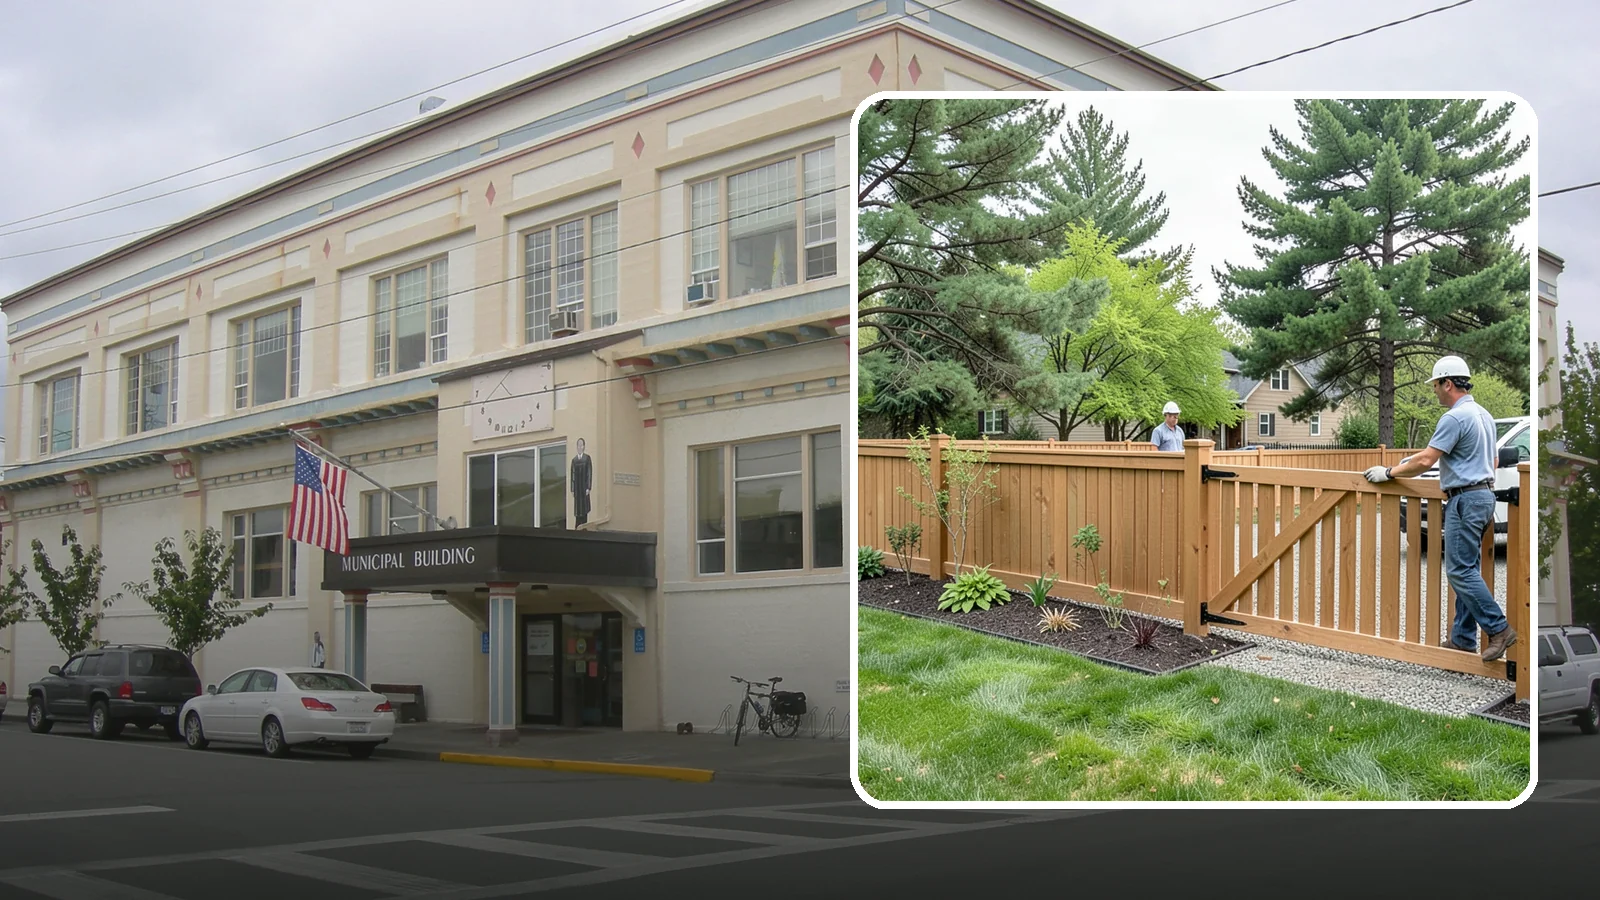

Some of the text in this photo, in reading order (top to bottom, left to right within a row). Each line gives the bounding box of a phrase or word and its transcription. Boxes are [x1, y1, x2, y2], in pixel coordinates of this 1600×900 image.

[546, 362, 551, 370] 6
[475, 390, 479, 398] 7
[536, 402, 540, 410] 4
[481, 407, 485, 415] 8
[488, 418, 492, 426] 9
[529, 414, 533, 422] 3
[494, 424, 500, 432] 10
[521, 421, 525, 429] 2
[342, 547, 475, 572] MUNICIPAL BUILDING
